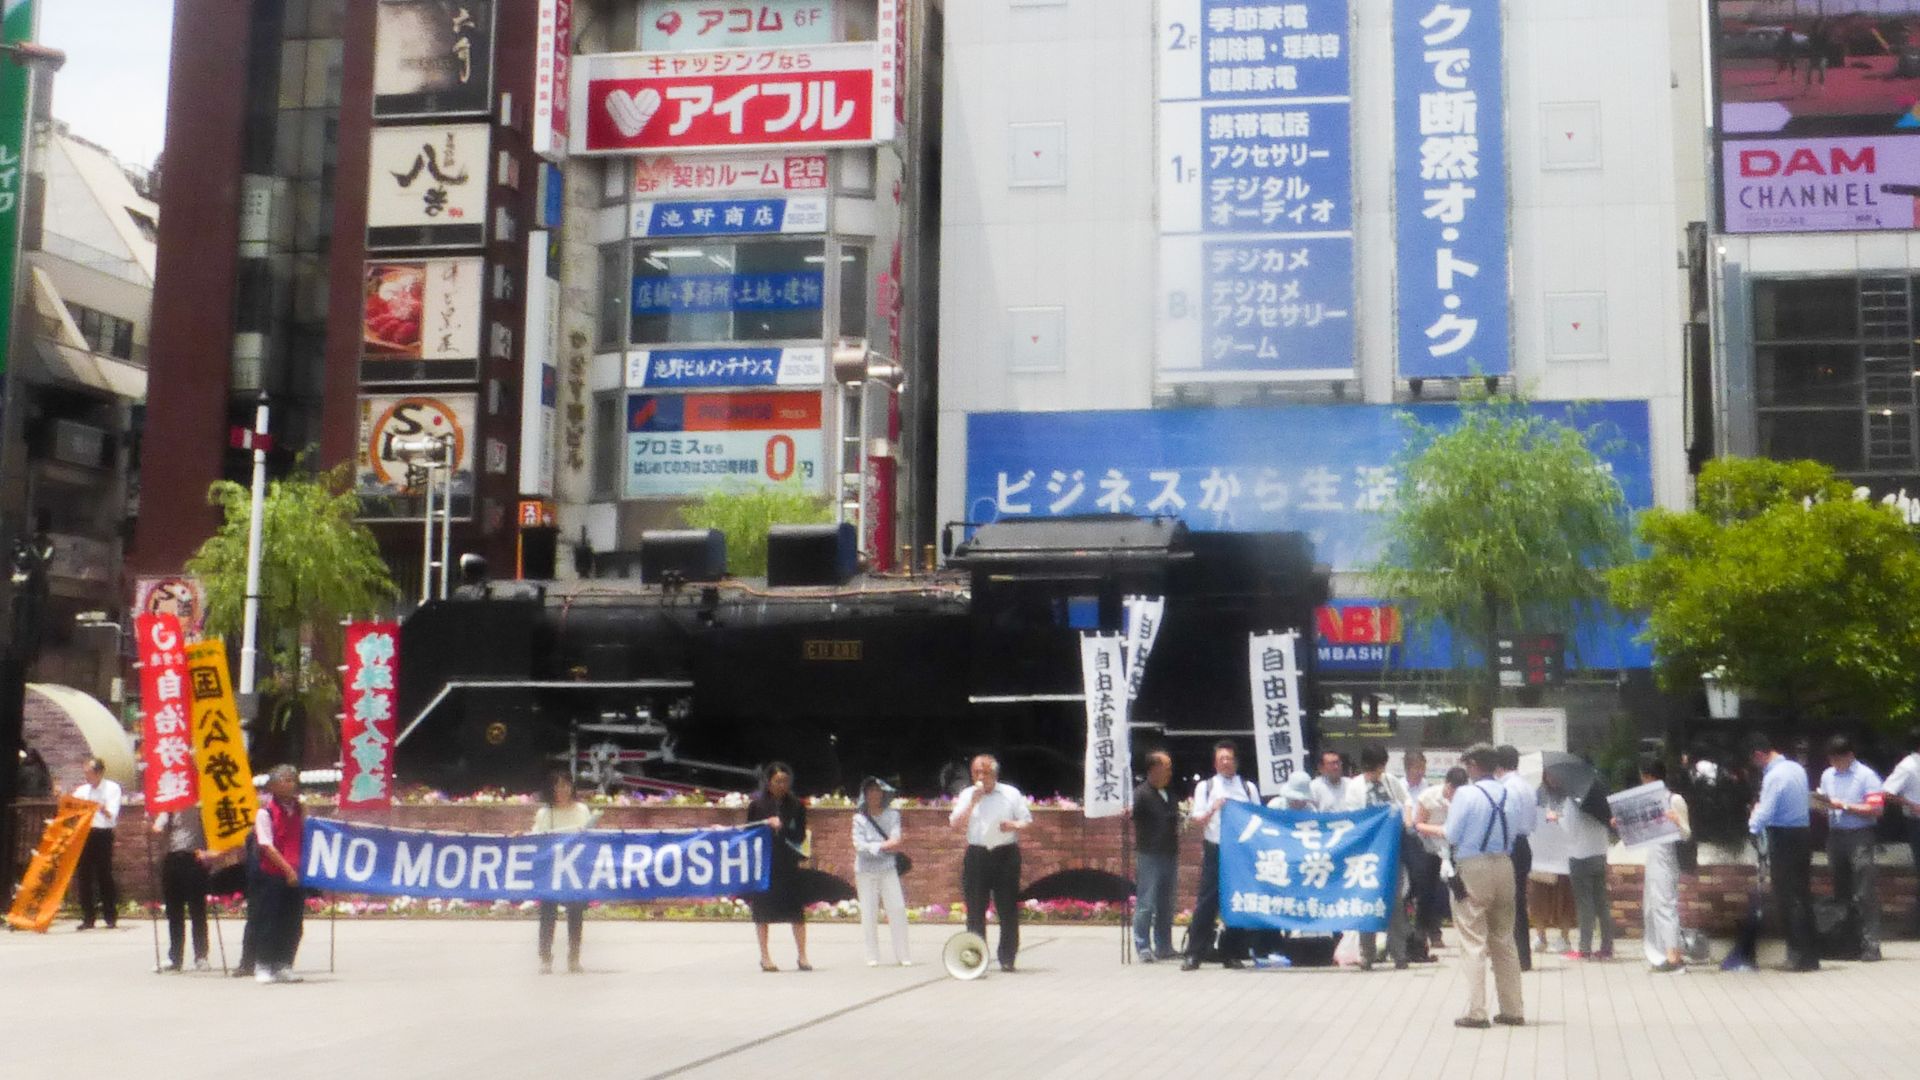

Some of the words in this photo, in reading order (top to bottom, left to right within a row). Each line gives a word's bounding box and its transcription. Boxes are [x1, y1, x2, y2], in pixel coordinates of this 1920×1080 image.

[697, 6, 783, 36] アコム
[794, 9, 822, 27] 6F
[648, 52, 812, 74] キャッシングなら
[666, 80, 856, 135] アイフル
[1209, 112, 1310, 140] 携帯電話
[1209, 142, 1330, 169] アクセサリー
[1739, 147, 1875, 178] DAM
[673, 163, 780, 188] 契約ルーム
[1210, 175, 1310, 202] デジタル
[1419, 4, 1479, 357] クで断然オ・ト・ク
[1739, 184, 1878, 209] CHANNEL
[661, 206, 774, 228] 池野商店
[1211, 199, 1336, 225] オーディオ
[1212, 248, 1310, 273] デジカメ
[1212, 280, 1300, 303] デジカメ
[1211, 303, 1348, 328] アクセサリー
[1212, 335, 1279, 360] ゲーム
[765, 434, 796, 482] 0
[1238, 814, 1355, 849] ノーモア
[307, 830, 378, 883] NO
[391, 840, 538, 891] MORE
[551, 836, 764, 892] KAROSHI
[1255, 849, 1380, 889] 過労死
